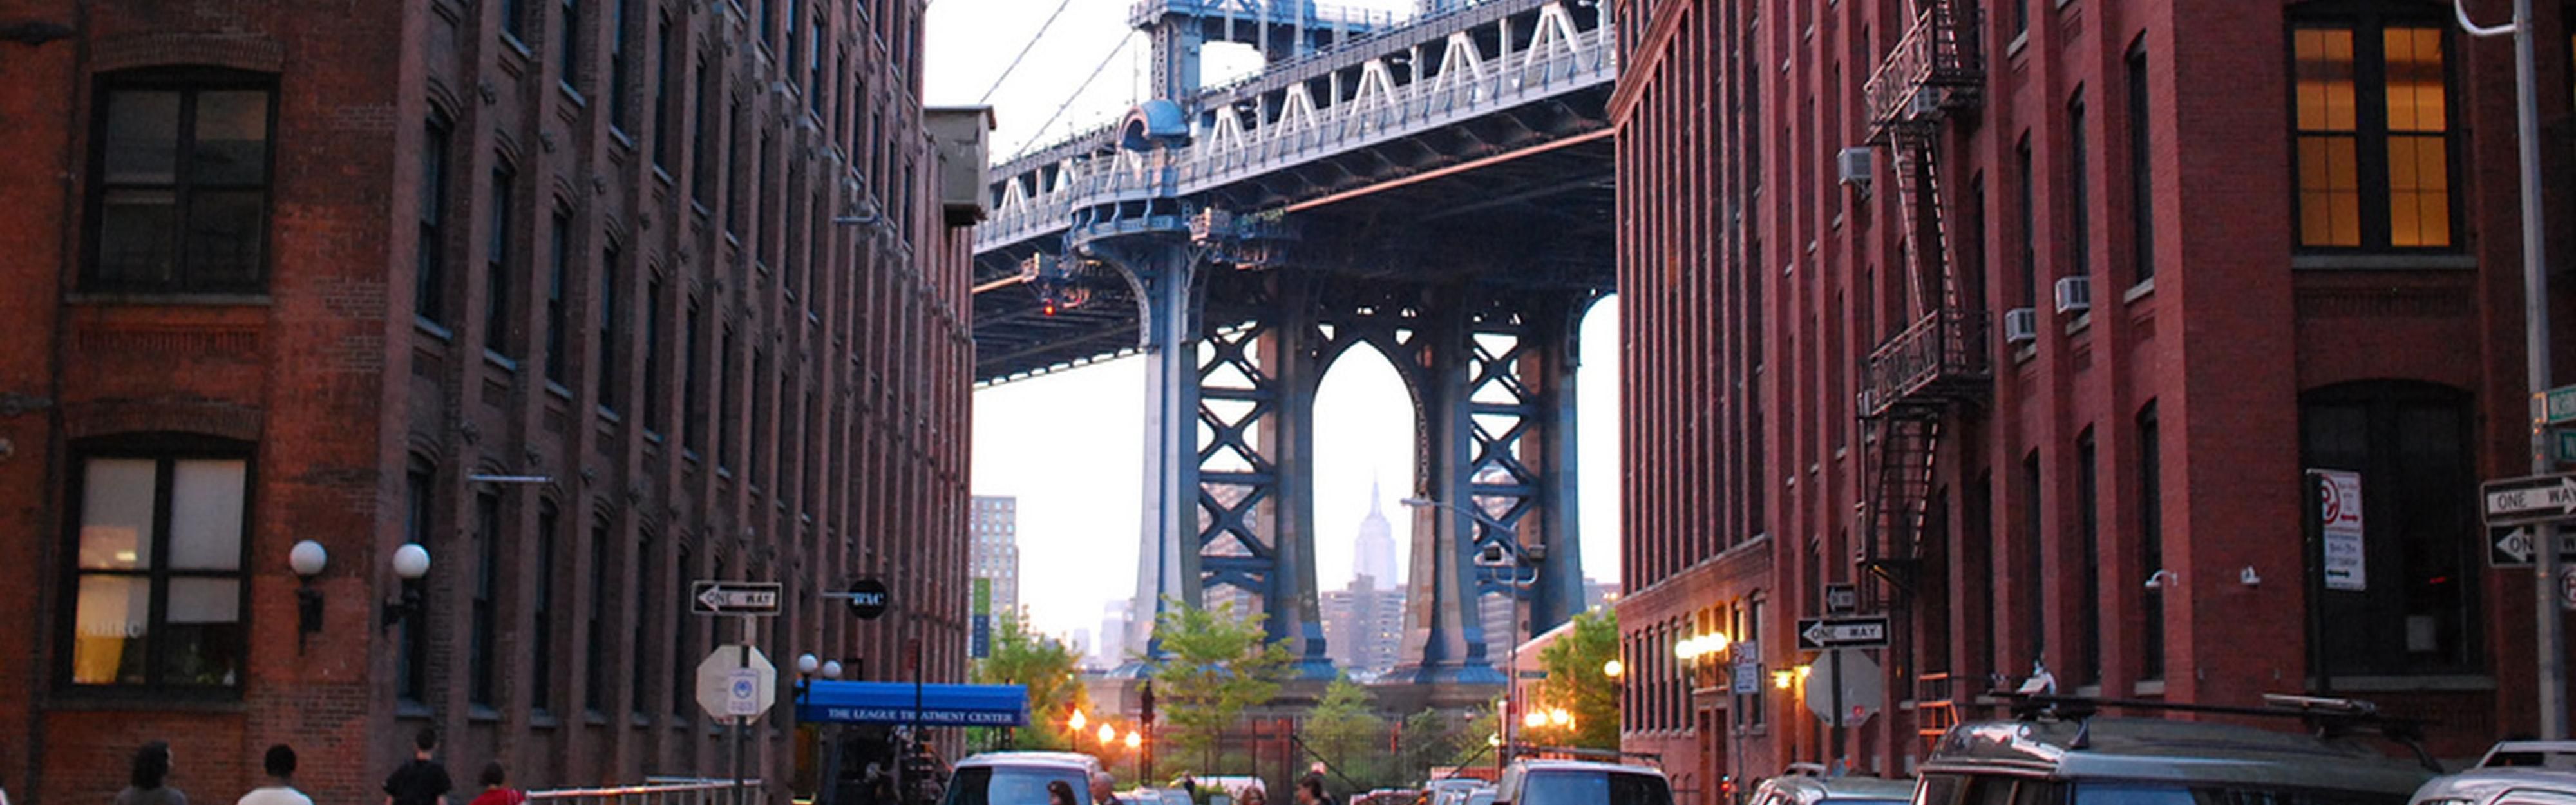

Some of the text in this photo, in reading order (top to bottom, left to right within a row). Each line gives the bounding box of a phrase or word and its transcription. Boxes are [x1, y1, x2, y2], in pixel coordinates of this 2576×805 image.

[2497, 491, 2527, 509] ONE
[2509, 536, 2535, 553] ON
[706, 591, 771, 605] ONE WAY
[1811, 626, 1876, 640] ONE WAY
[828, 708, 1012, 723] THE LEAGUE TRATMENT CENTER
